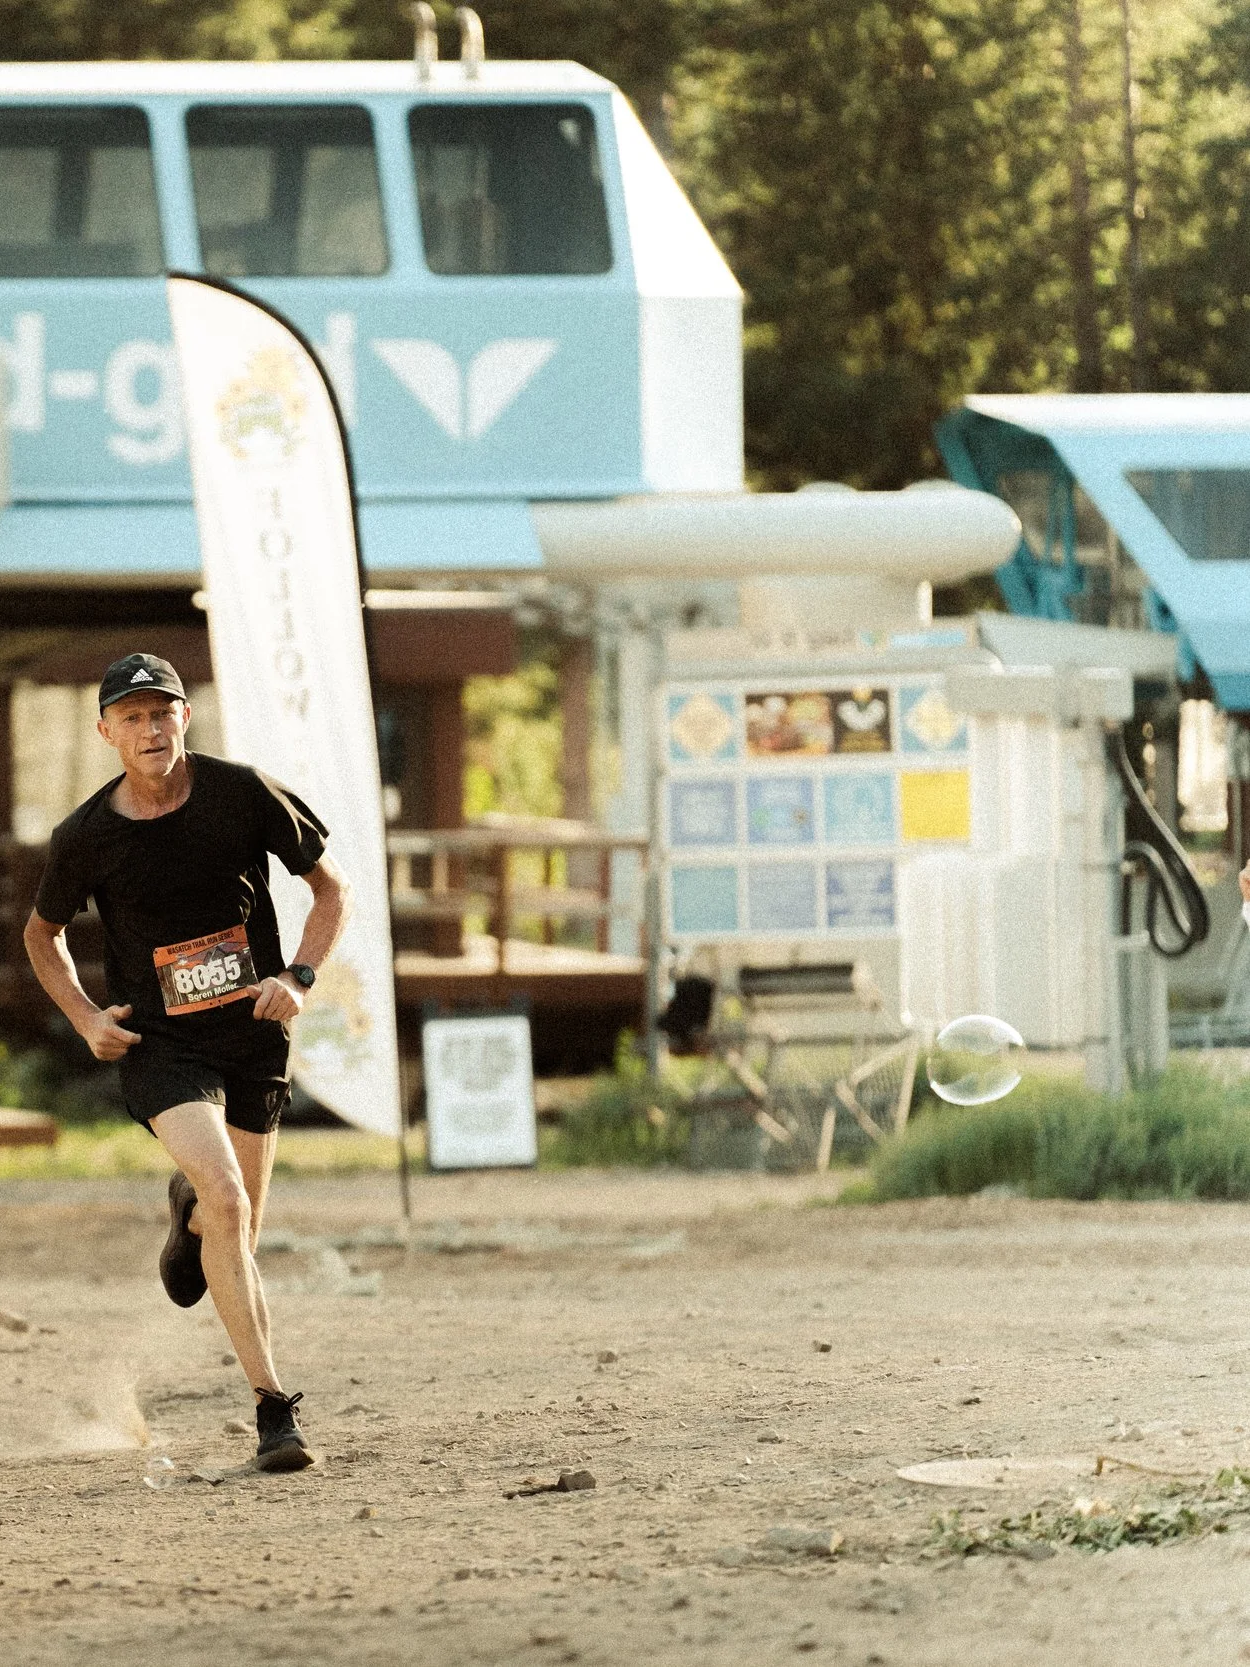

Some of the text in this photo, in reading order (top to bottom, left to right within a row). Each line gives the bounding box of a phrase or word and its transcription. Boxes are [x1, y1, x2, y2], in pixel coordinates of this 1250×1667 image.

[192, 940, 207, 948] TRAIL
[174, 954, 241, 994] 8055
[188, 991, 212, 1001] Soren
